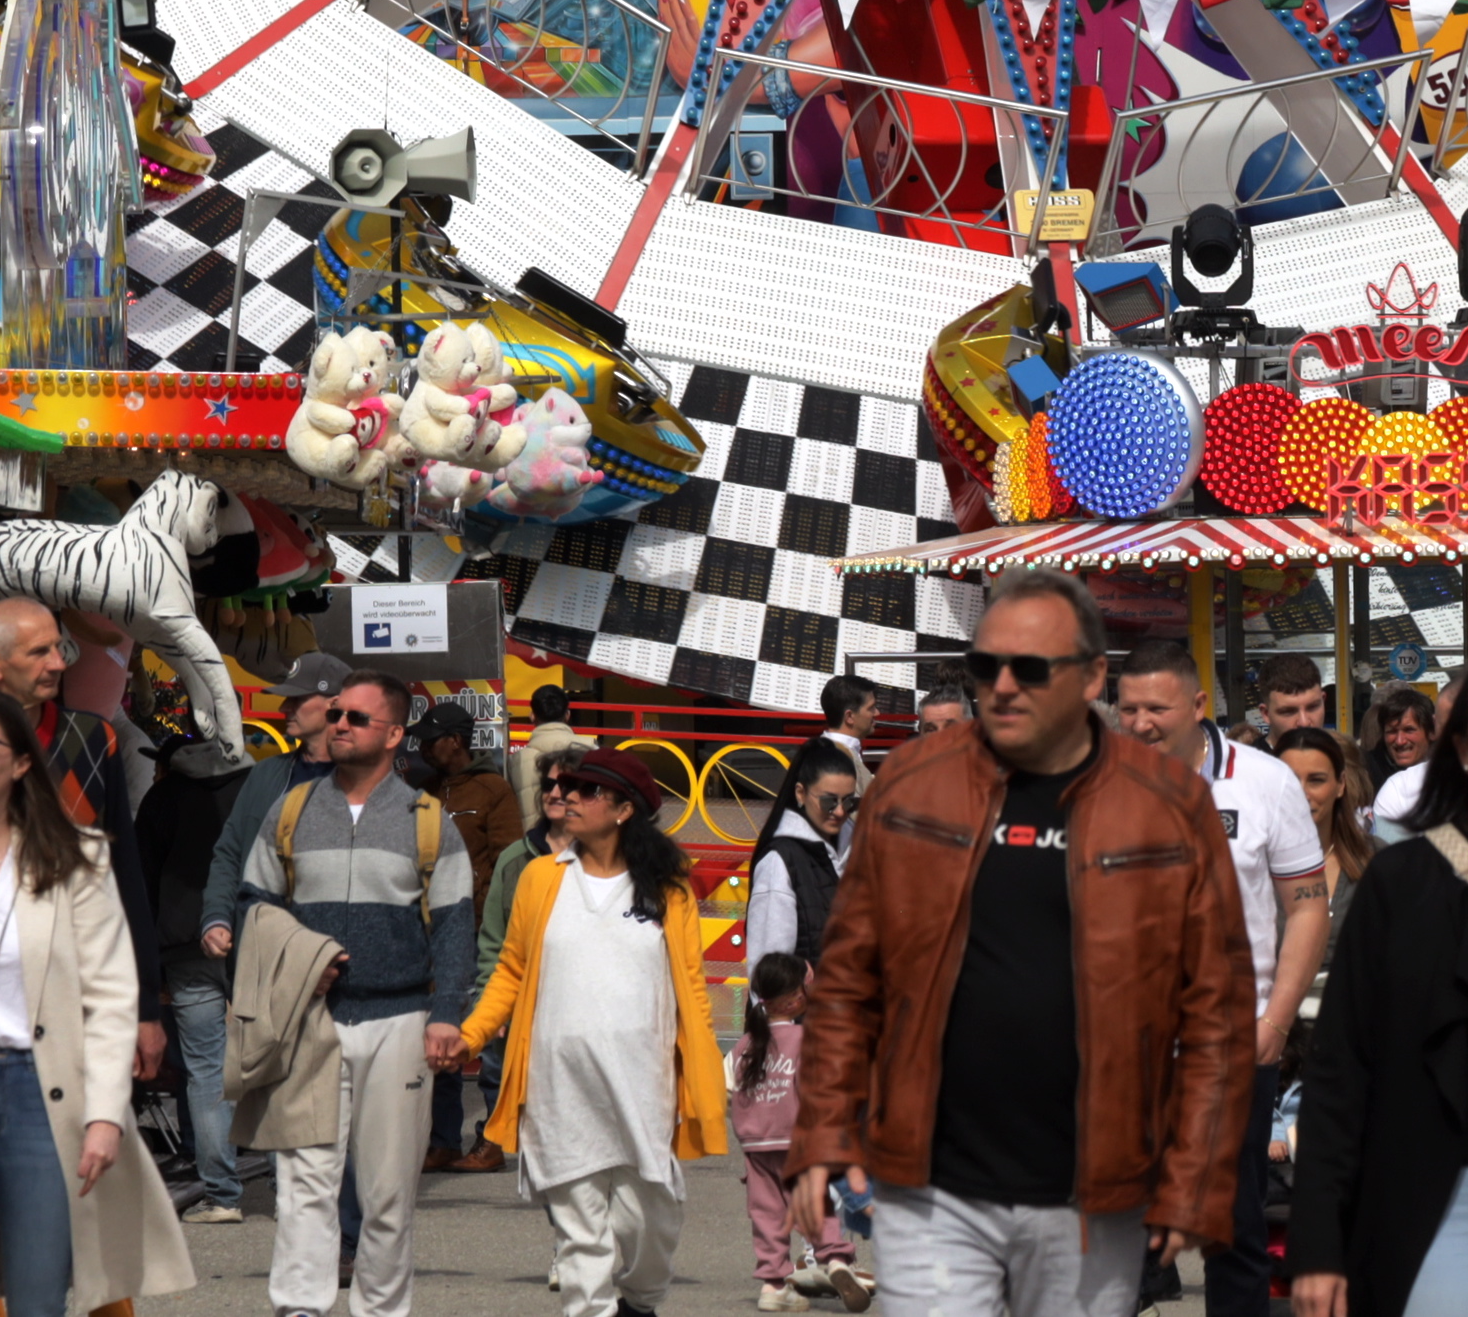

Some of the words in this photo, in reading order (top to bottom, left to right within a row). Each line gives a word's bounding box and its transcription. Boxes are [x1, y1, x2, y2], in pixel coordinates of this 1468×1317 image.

[372, 599, 396, 608] Dieser
[398, 599, 426, 607] Bereich
[362, 611, 378, 619] wird
[380, 609, 436, 618] videoüberwacht
